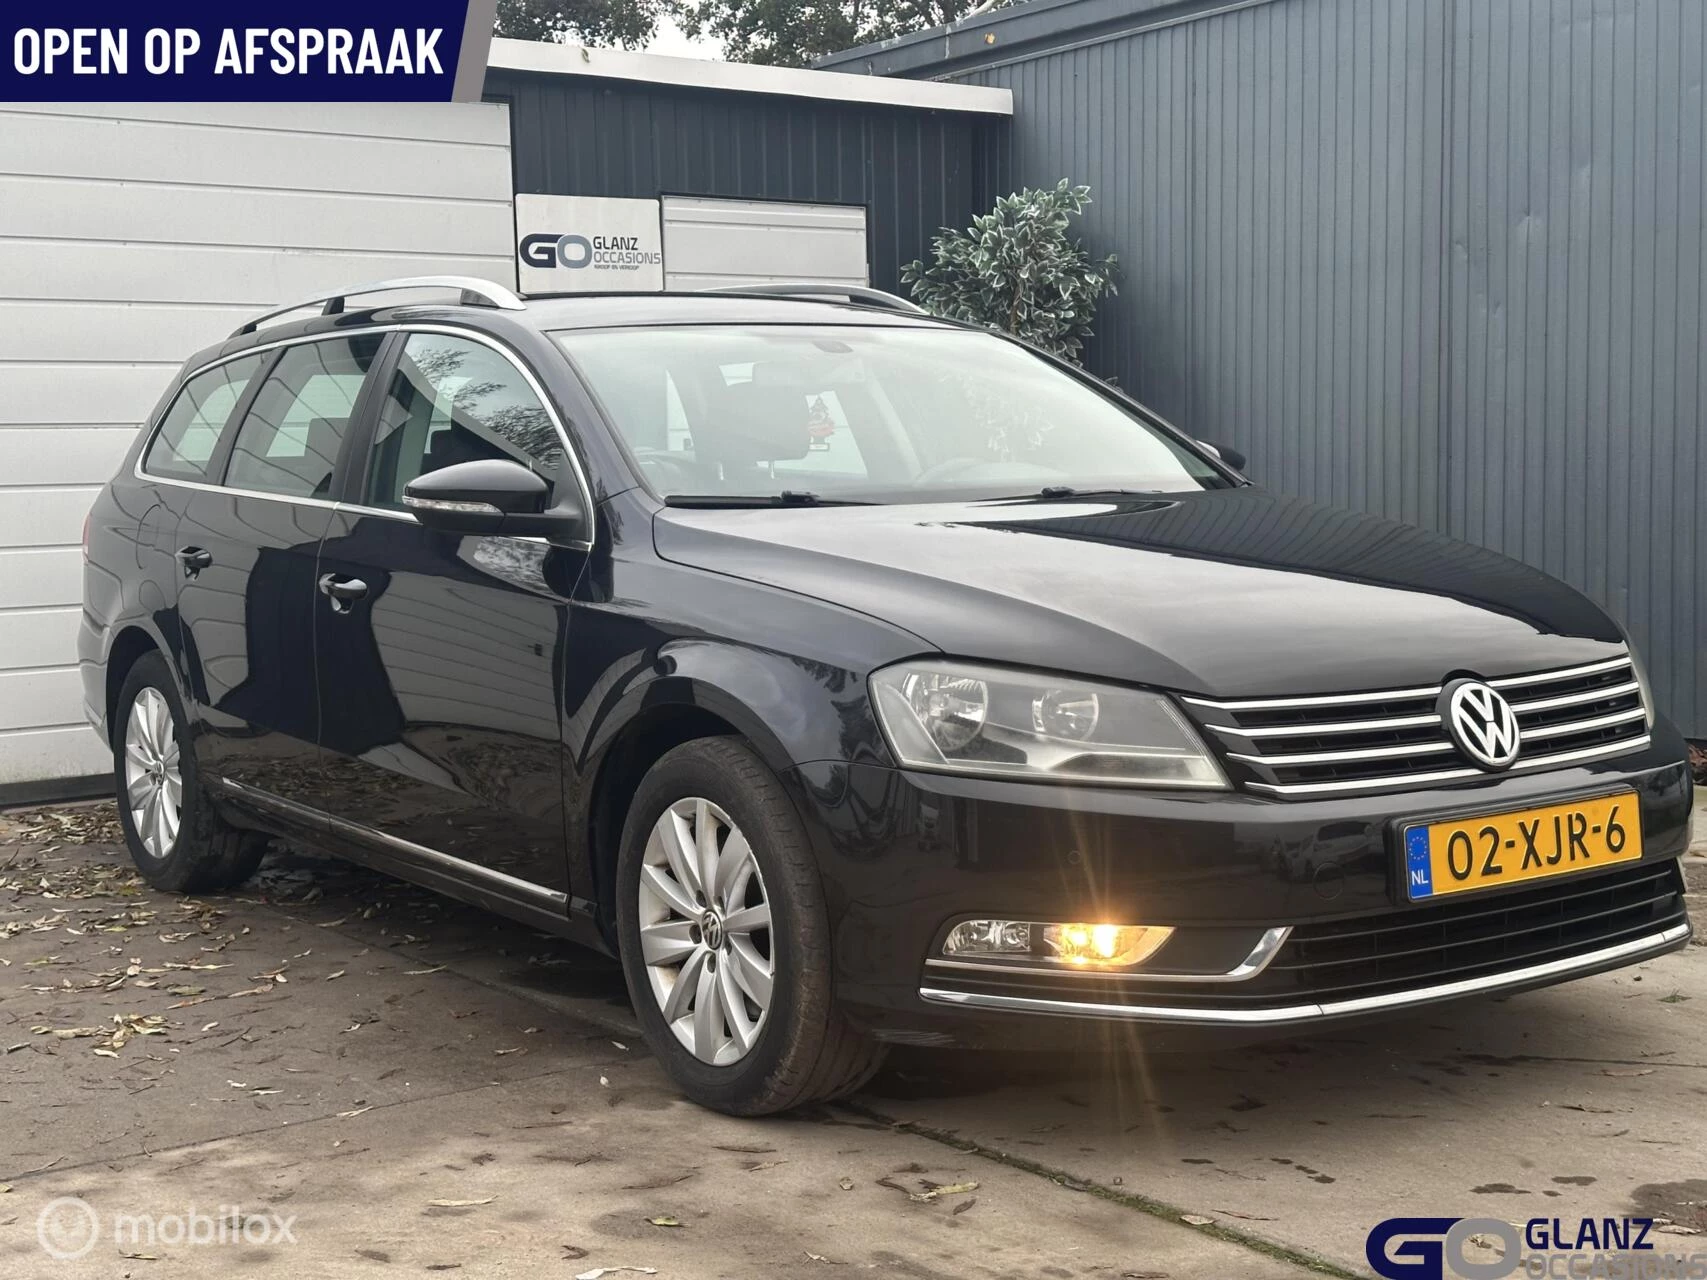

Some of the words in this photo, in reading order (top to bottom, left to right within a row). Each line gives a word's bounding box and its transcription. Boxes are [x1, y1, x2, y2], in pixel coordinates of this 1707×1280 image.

[519, 233, 593, 269] GO
[592, 236, 639, 251] GLANZ
[593, 251, 661, 265] OCCASIONS
[1447, 805, 1626, 881] 02-XJR-6
[1411, 869, 1429, 887] NL
